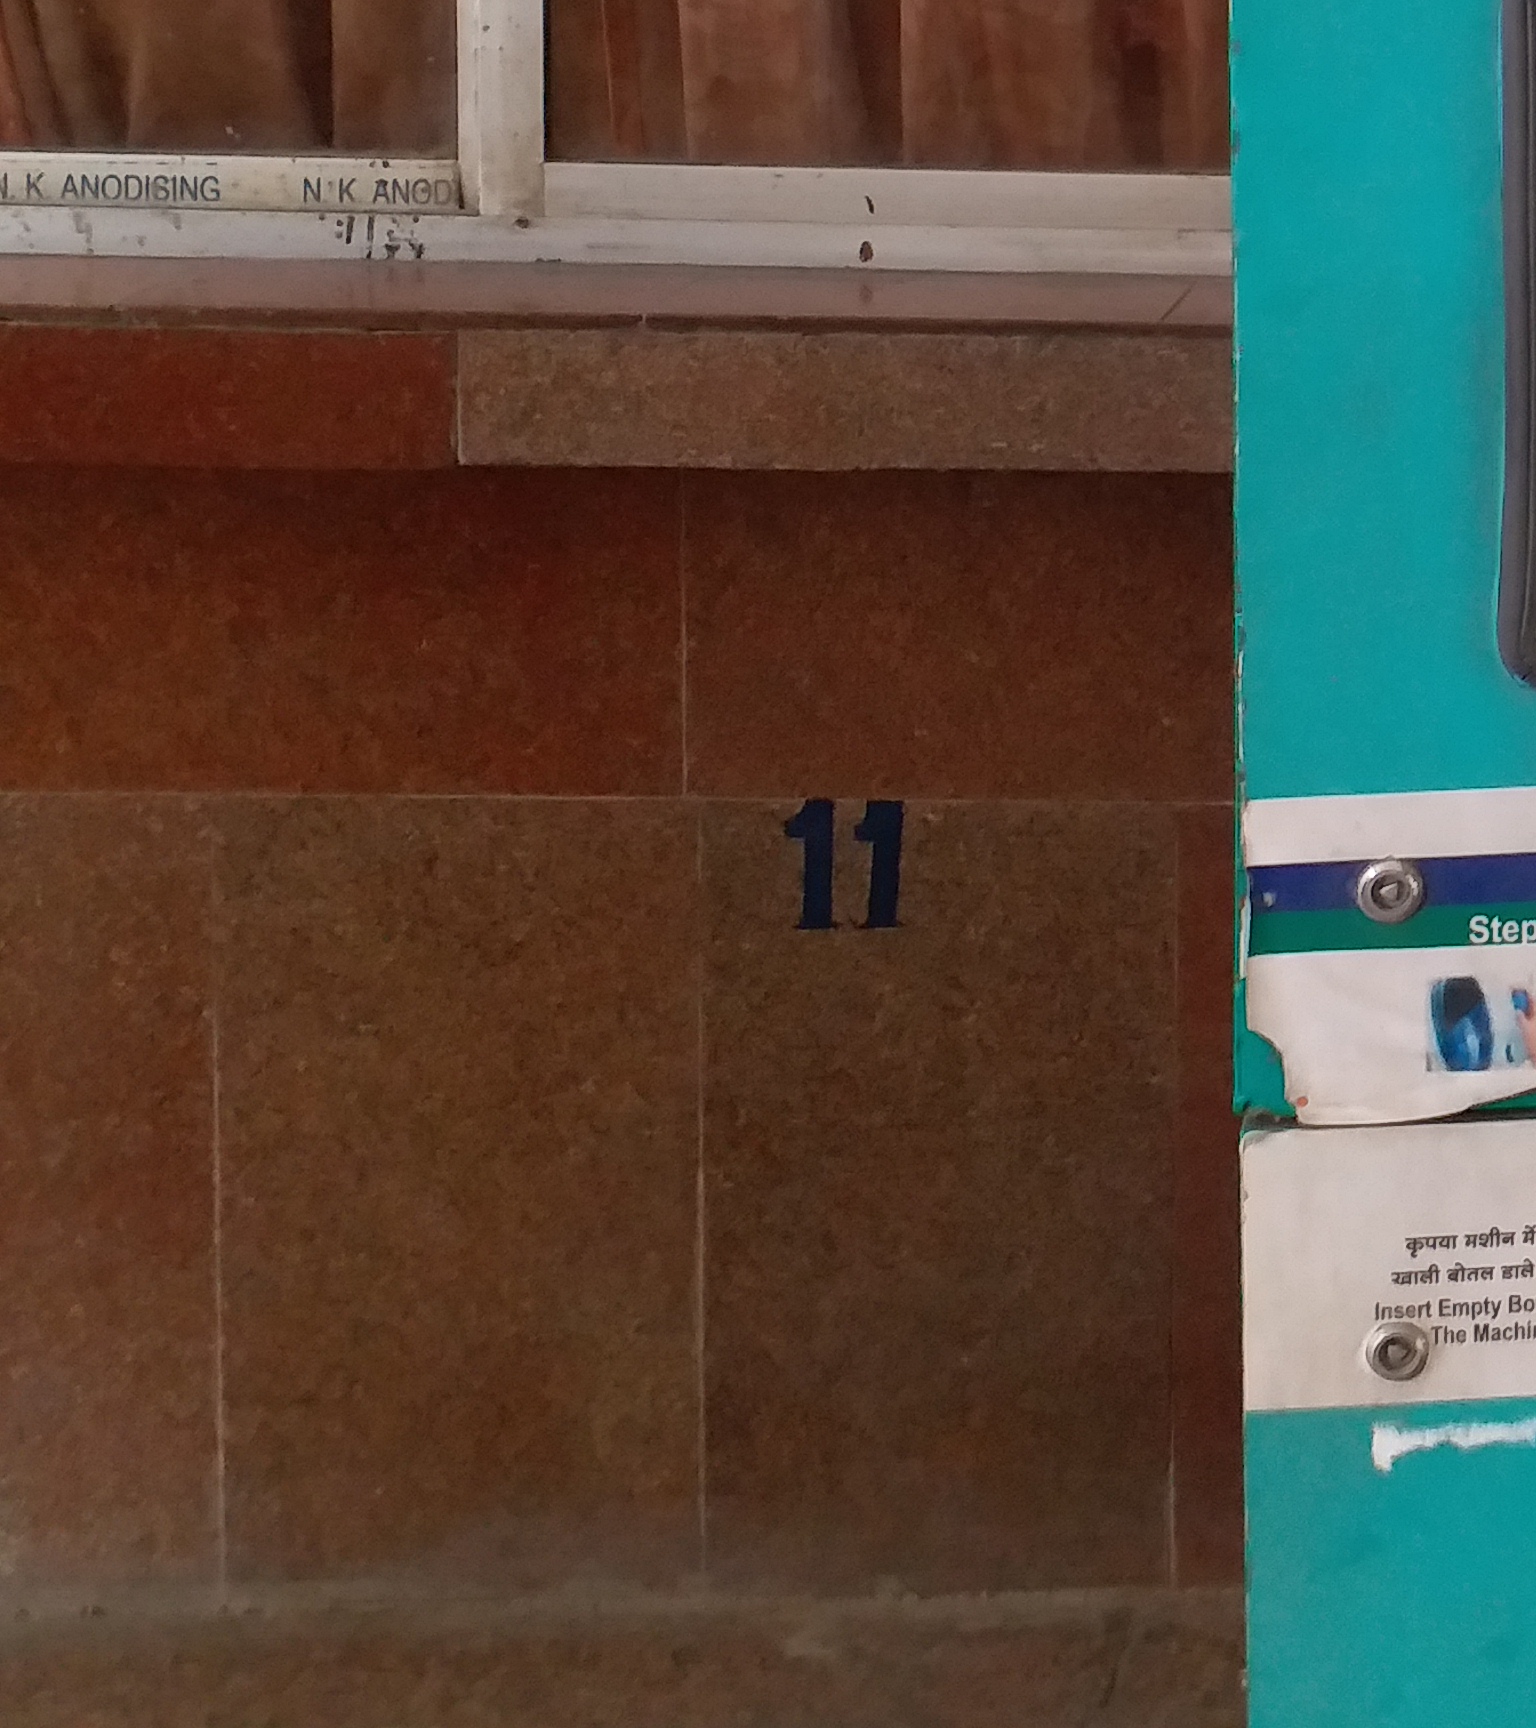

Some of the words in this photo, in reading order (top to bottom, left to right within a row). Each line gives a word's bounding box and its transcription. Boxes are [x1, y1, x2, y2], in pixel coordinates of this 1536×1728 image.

[61, 174, 221, 203] ANODISING
[784, 798, 906, 930] 11
[1405, 1234, 1459, 1259] कृपया
[1464, 1226, 1516, 1248] मशीन
[1522, 1224, 1536, 1246] में
[1391, 1263, 1441, 1285] खाली
[1374, 1300, 1433, 1321] Insert
[1438, 1296, 1503, 1321] Empty
[1430, 1325, 1468, 1346] The
